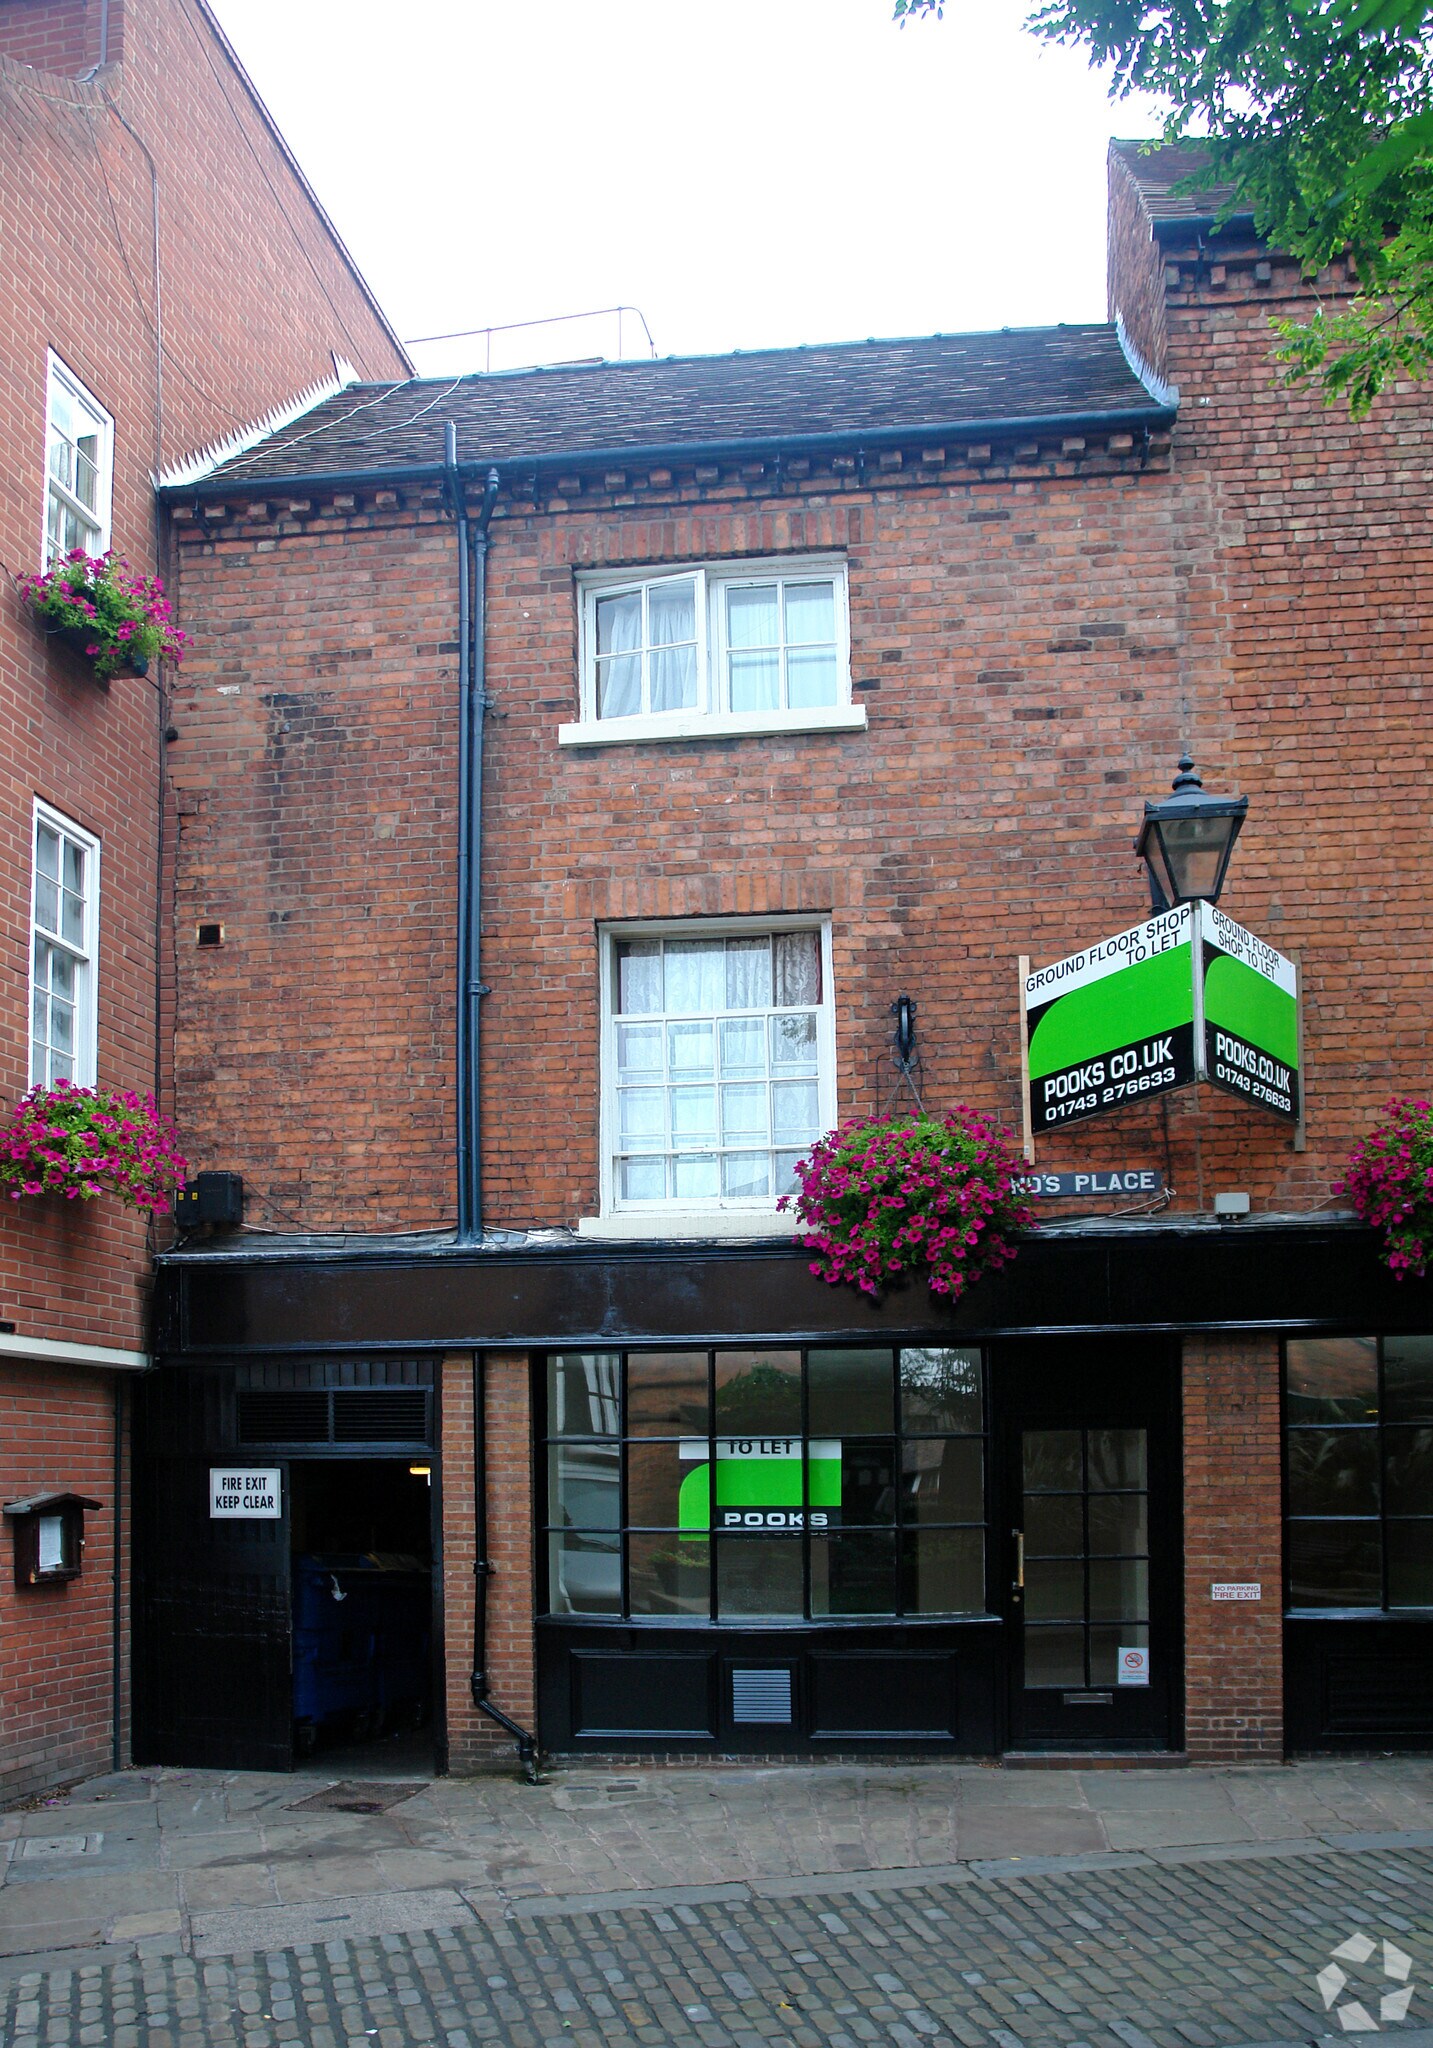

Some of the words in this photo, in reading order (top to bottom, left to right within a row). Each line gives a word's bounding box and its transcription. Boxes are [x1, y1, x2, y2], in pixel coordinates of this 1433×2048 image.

[1026, 956, 1085, 992] GROUND
[1089, 930, 1141, 965] FLOOR
[1146, 908, 1190, 939] SHOP
[1125, 945, 1146, 965] TO
[1151, 930, 1181, 955] LET
[1212, 908, 1250, 946] GROUND
[1252, 937, 1280, 969] FLOOR
[1218, 930, 1243, 957] SHOP
[1246, 948, 1258, 968] TO
[1260, 959, 1275, 980] LET
[1044, 1061, 1105, 1103] POOKS
[1110, 1036, 1173, 1079] CO.UK
[1216, 1032, 1290, 1093] POOKS.CO.UK
[1045, 1093, 1097, 1121] 01743
[1102, 1067, 1175, 1103] 276633
[1216, 1063, 1250, 1091] 01743
[1252, 1082, 1291, 1112] 276633
[1075, 1172, 1155, 1192] PLACE
[728, 1440, 753, 1454] TO
[760, 1440, 793, 1454] LET
[215, 1495, 240, 1509] KEEP
[243, 1495, 274, 1509] CLEAR
[222, 1477, 242, 1490] FIRE
[245, 1477, 267, 1490] EXIT
[724, 1512, 828, 1526] POOKS
